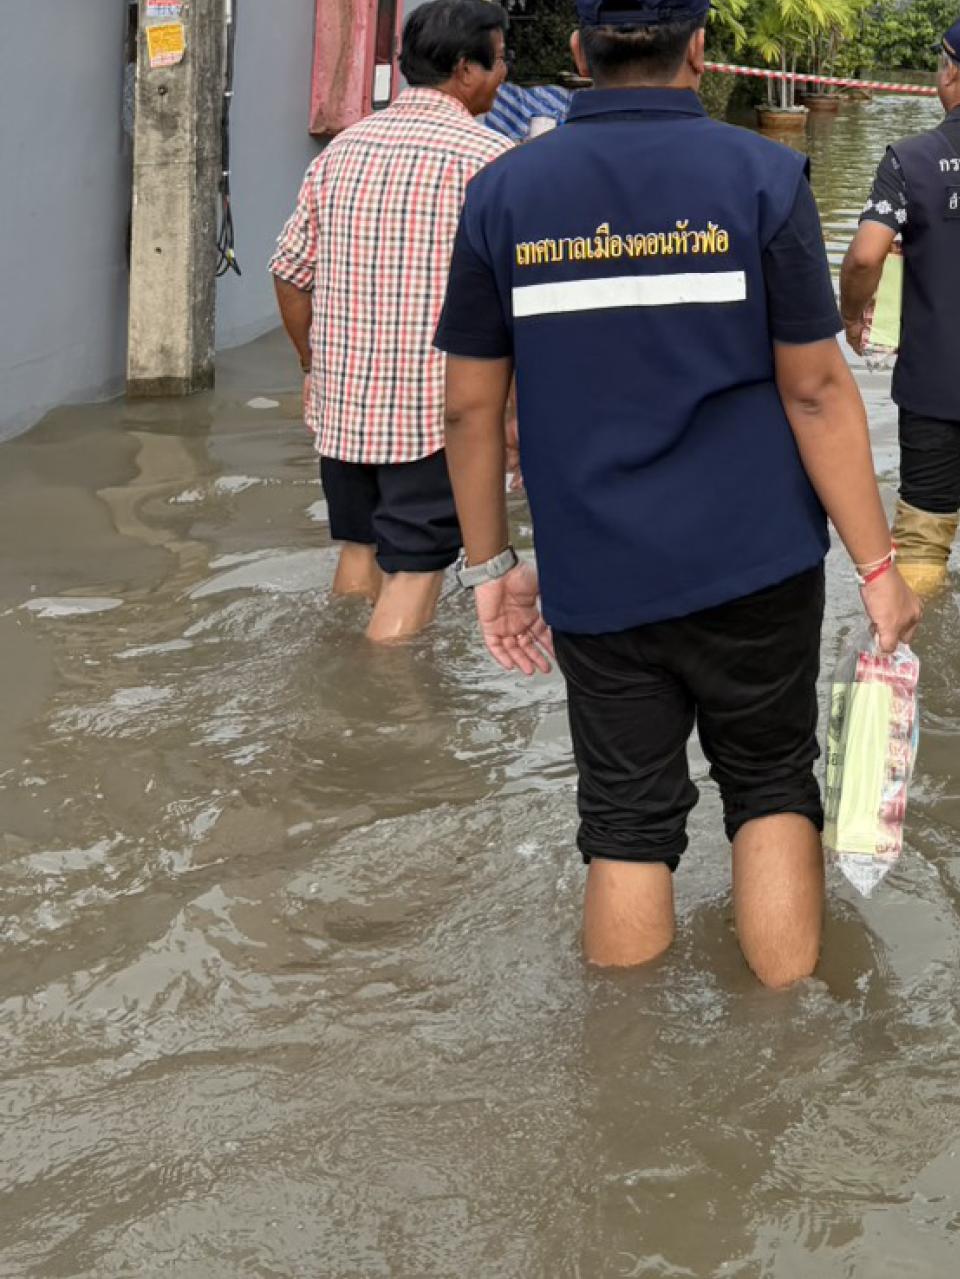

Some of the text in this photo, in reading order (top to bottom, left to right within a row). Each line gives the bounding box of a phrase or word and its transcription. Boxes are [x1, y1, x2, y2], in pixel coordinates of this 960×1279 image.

[515, 219, 730, 266] เทศบาลเมืองดอนหัวฬ่อ
